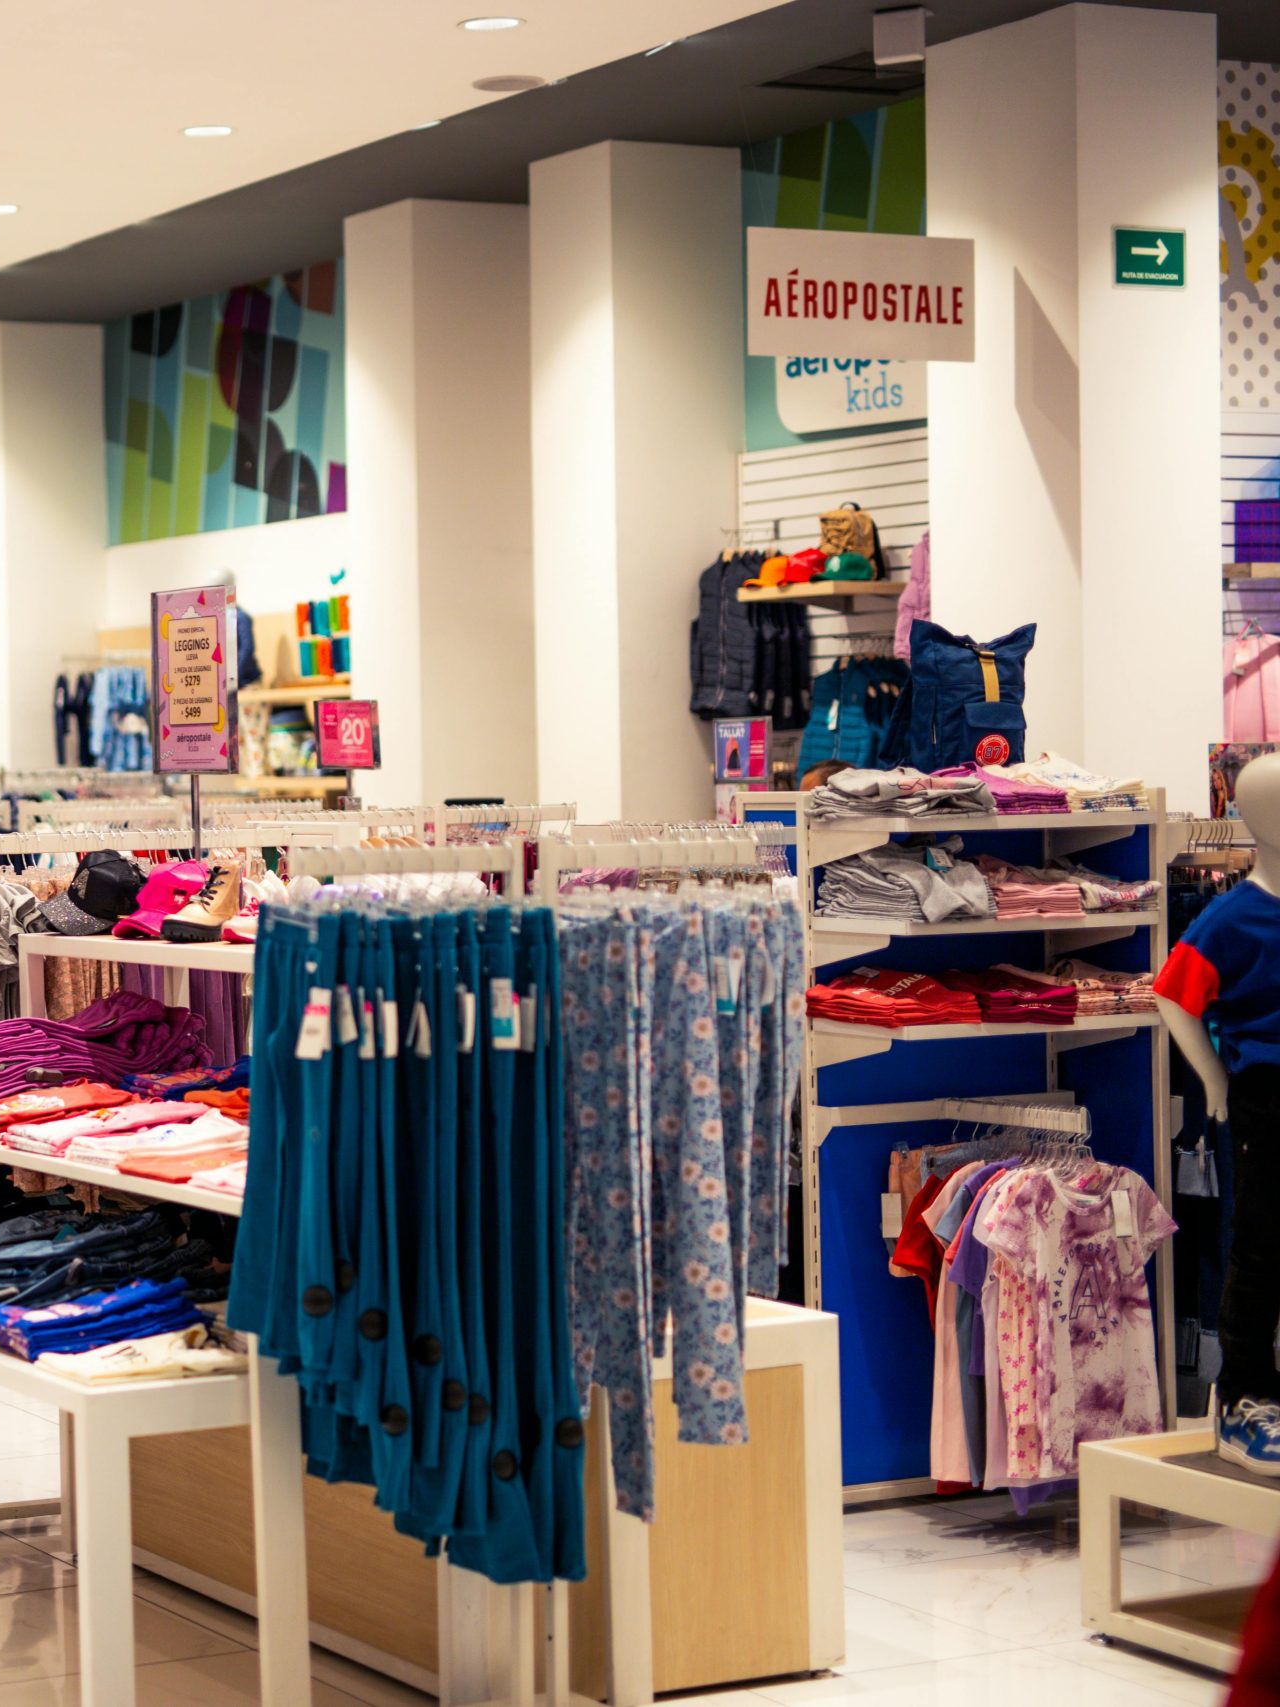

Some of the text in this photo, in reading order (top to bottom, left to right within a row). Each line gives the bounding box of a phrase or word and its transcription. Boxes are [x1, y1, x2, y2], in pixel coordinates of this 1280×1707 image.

[764, 268, 963, 325] AÉROPOSTALE
[845, 370, 903, 413] kids
[174, 638, 210, 652] LEGGINGS
[184, 675, 201, 687] $279
[185, 705, 201, 719] $499
[176, 732, 212, 743] aéropostale
[984, 745, 1002, 759] 87
[1069, 1263, 1107, 1320] A
